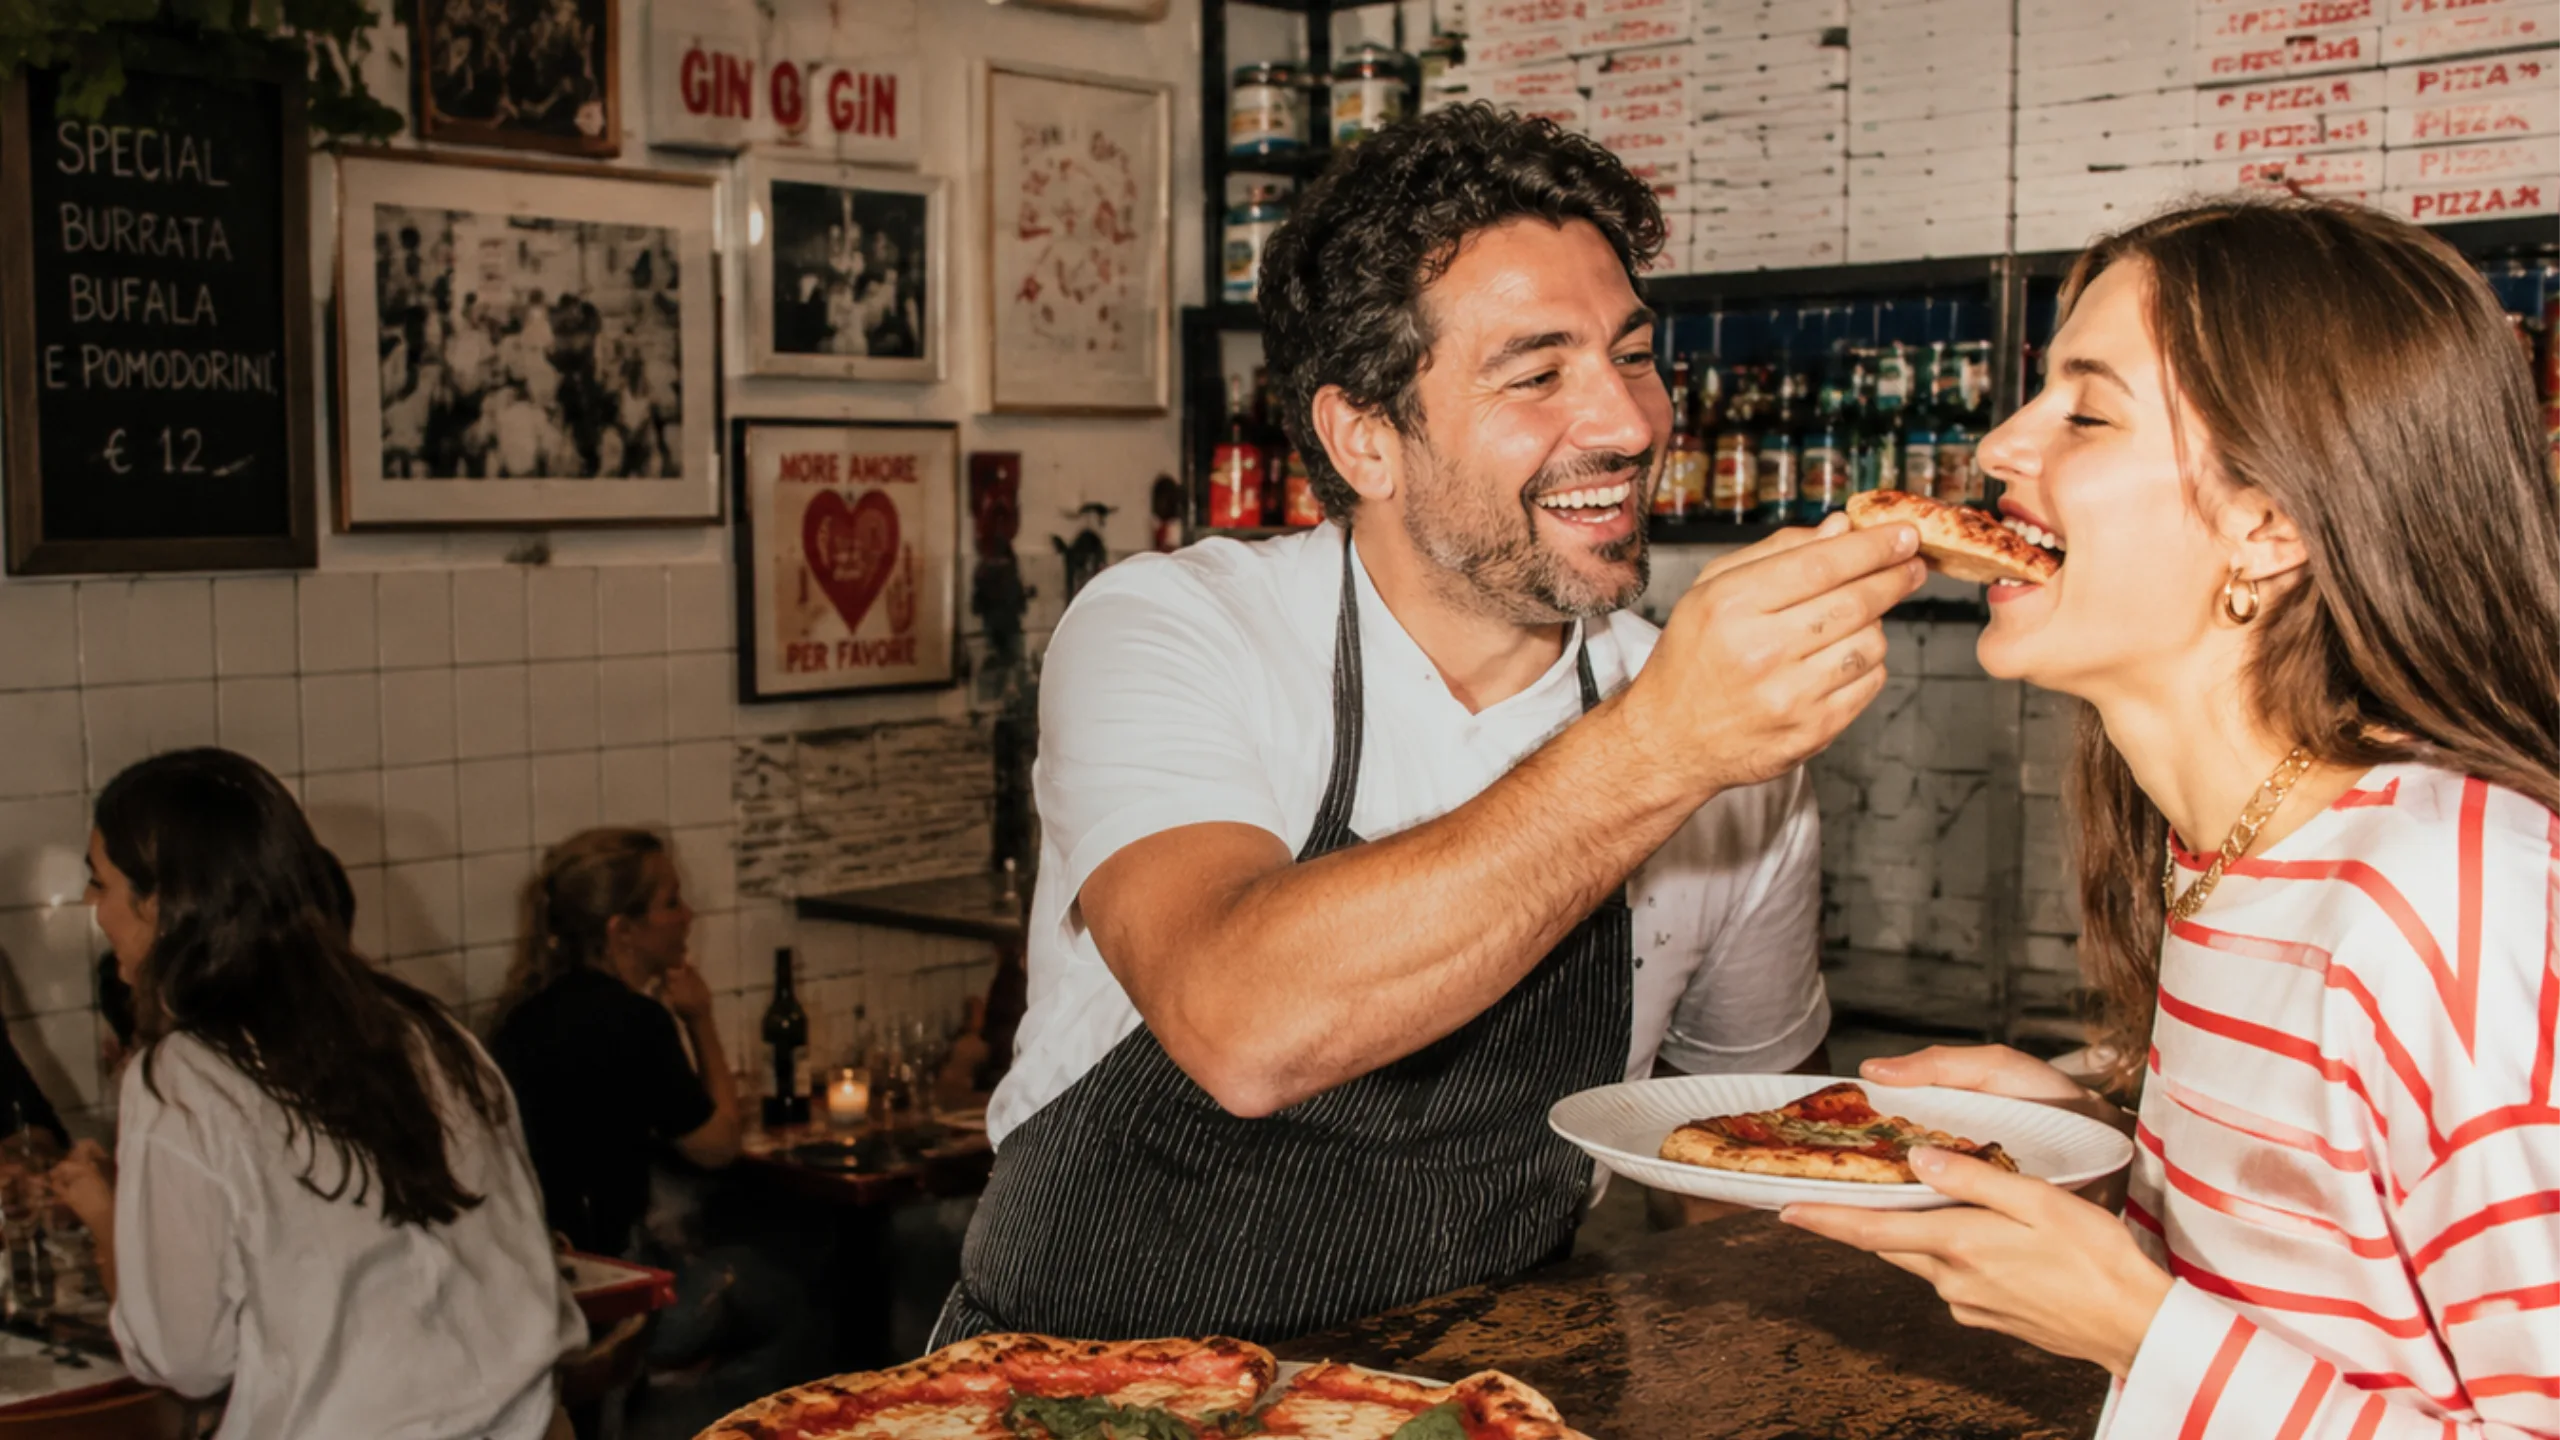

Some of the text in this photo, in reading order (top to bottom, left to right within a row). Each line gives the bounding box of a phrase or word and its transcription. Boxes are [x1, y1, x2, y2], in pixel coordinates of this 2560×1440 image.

[680, 47, 754, 120] GIN
[827, 69, 896, 138] GIN
[57, 120, 230, 187] SPECIAL
[2412, 188, 2507, 219] PIZZA
[60, 202, 234, 262] BURRATA
[70, 273, 218, 326] BUFALA
[45, 344, 276, 396] E POMODORINI
[103, 426, 205, 474] € 12
[779, 453, 917, 484] MORE AMORE
[786, 638, 916, 673] PER FAVORE
